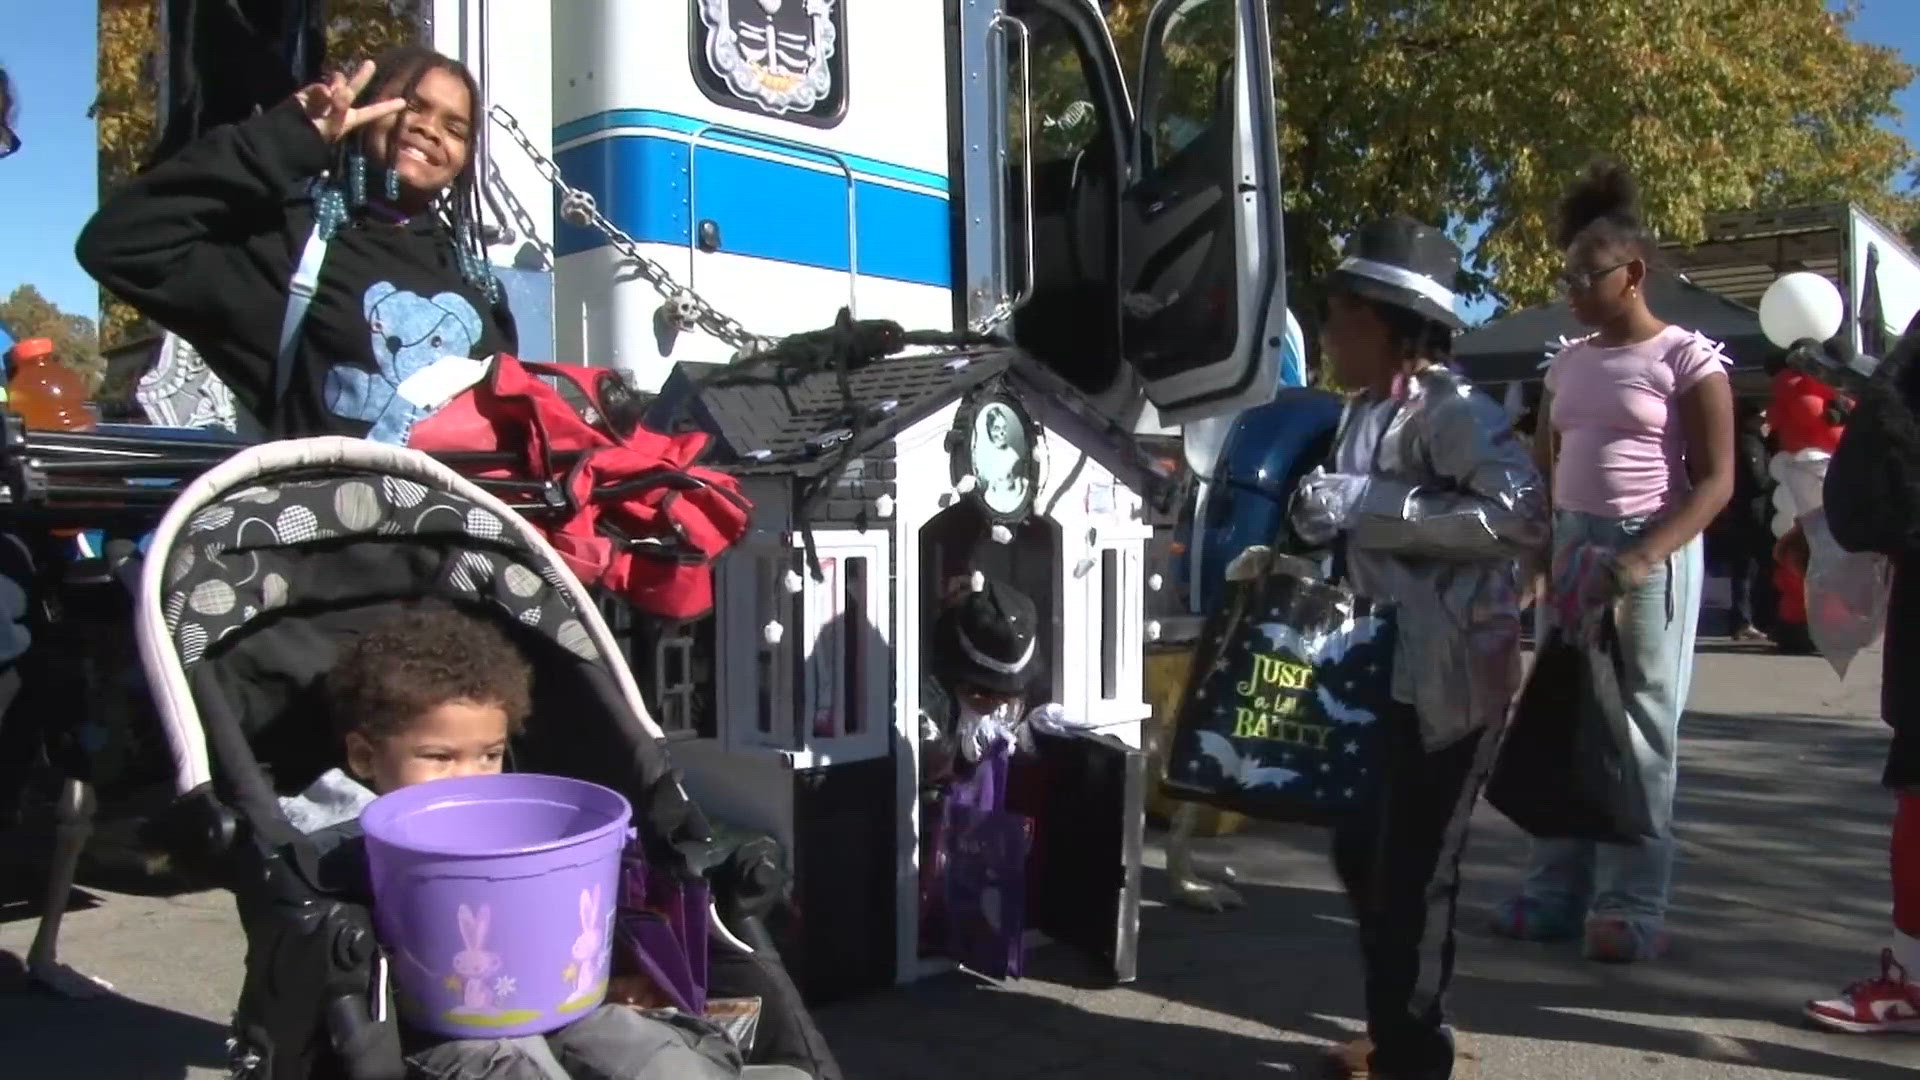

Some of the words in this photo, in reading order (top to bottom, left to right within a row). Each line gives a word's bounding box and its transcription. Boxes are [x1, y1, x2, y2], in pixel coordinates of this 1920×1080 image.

[1236, 653, 1313, 696] JUST
[1254, 696, 1270, 710] a
[1232, 707, 1337, 750] BATTY
